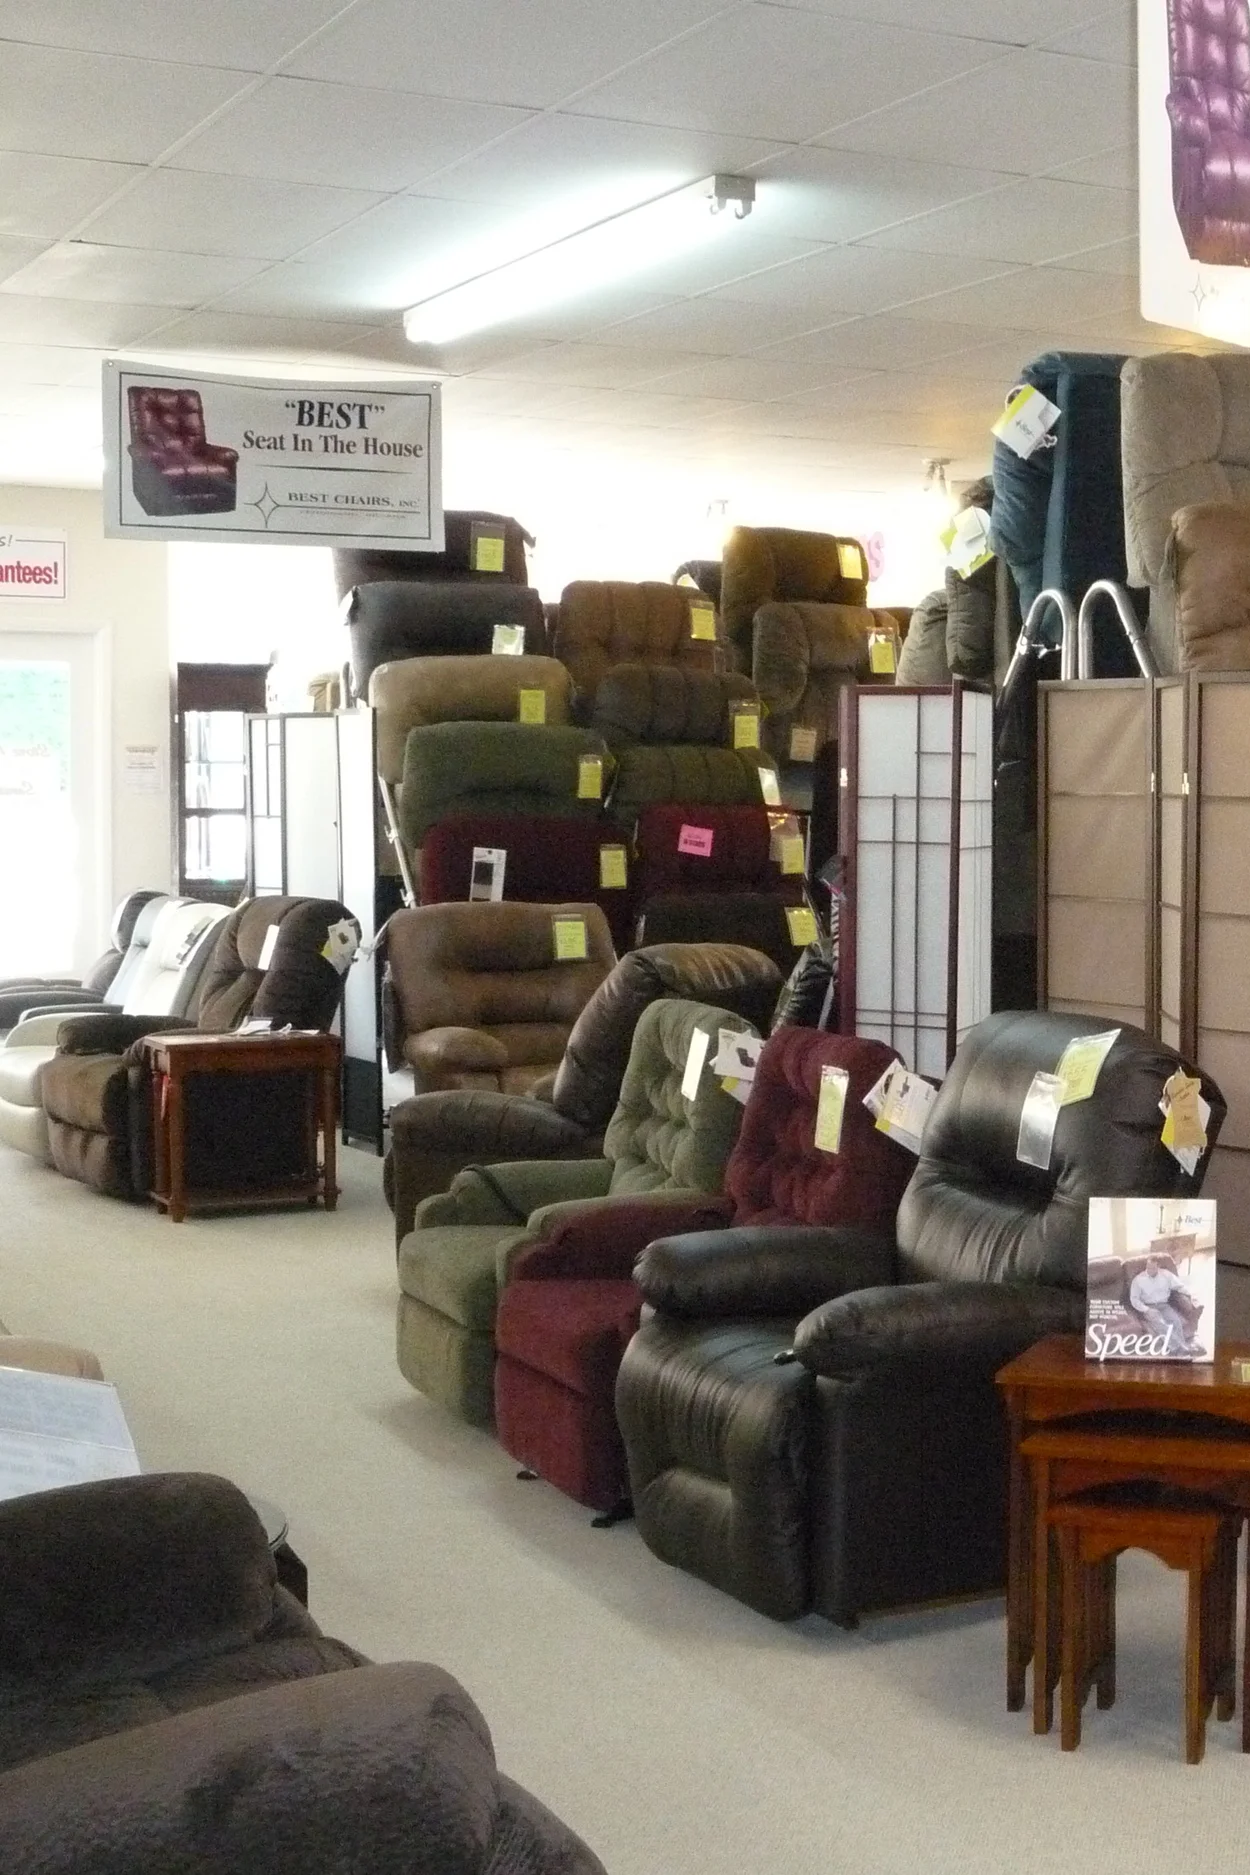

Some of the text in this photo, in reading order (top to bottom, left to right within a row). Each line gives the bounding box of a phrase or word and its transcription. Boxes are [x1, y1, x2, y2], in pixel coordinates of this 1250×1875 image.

[242, 430, 424, 459] Seat In The House
[288, 492, 329, 504] BEST
[334, 494, 395, 508] CHAIRS,
[1184, 1215, 1202, 1225] Best
[1085, 1323, 1173, 1361] Speed
